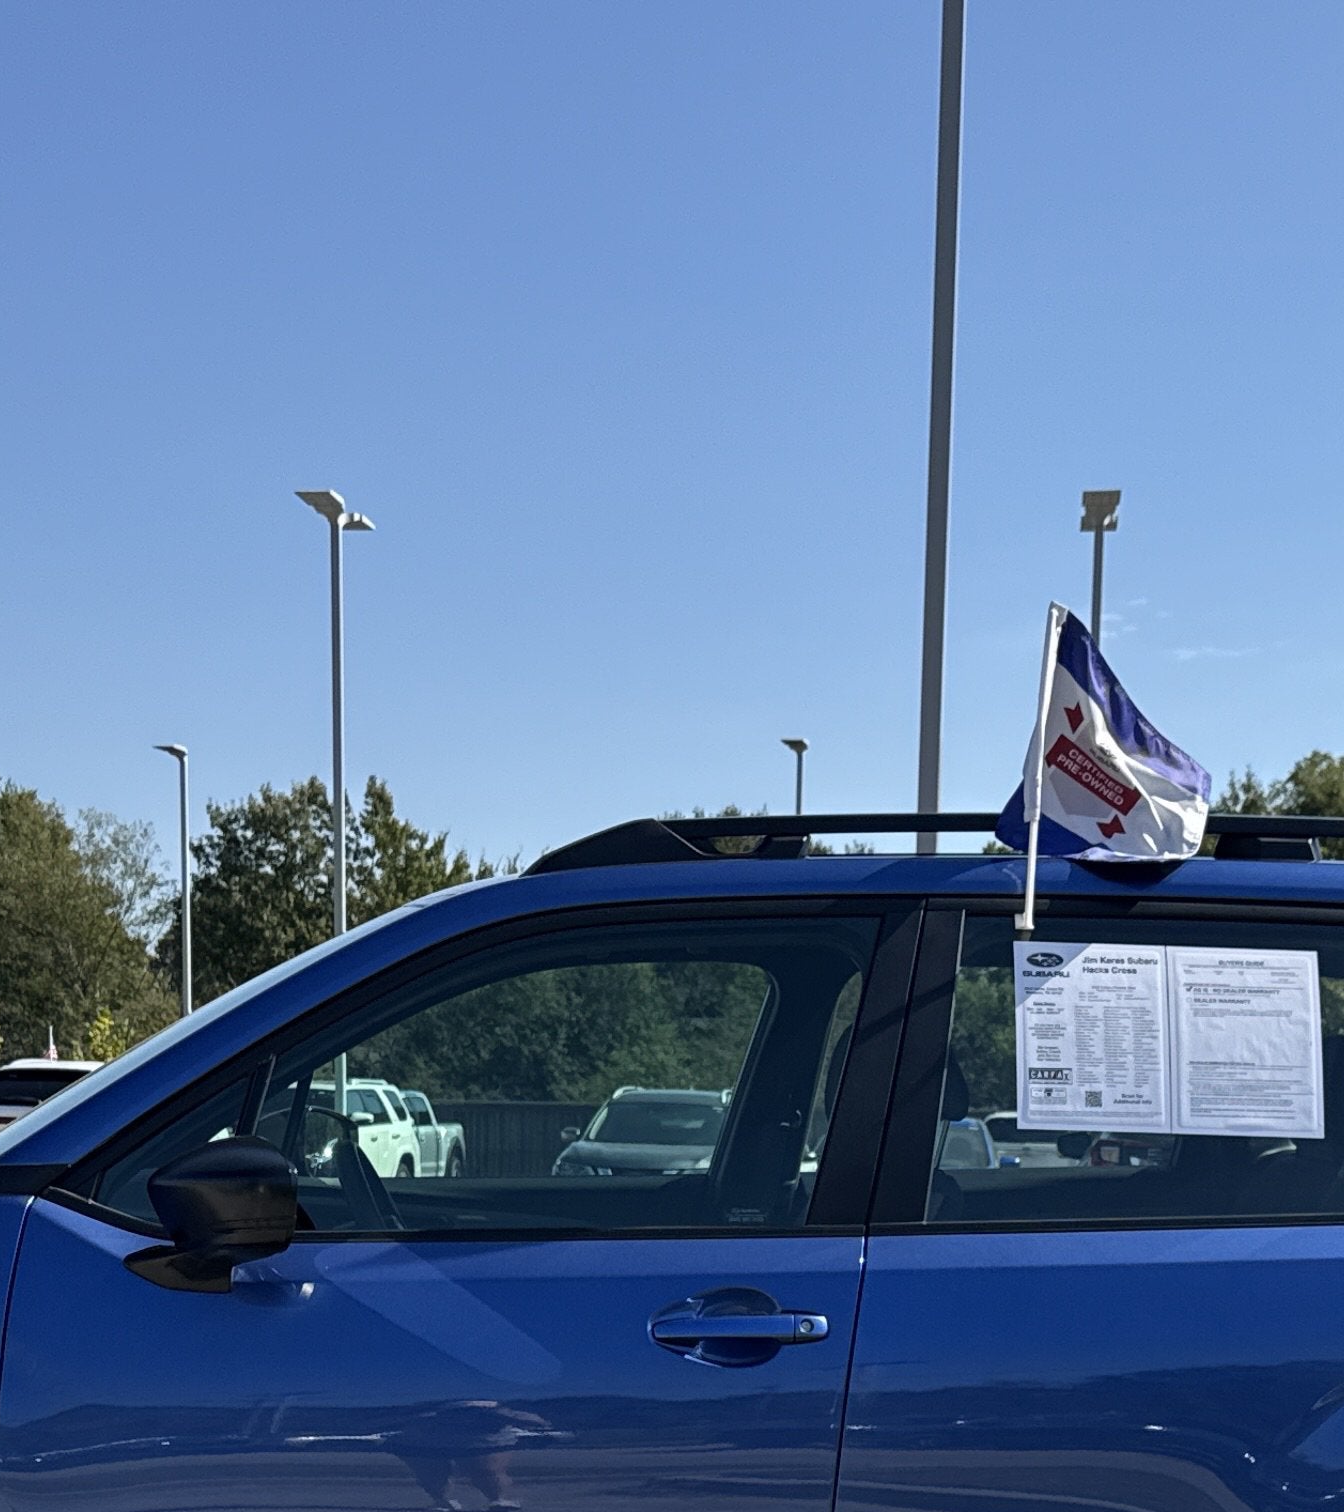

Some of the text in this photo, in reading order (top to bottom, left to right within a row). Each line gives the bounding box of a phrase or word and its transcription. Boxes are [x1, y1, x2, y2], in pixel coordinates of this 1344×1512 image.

[1068, 748, 1124, 794] CERTIFIED
[1056, 753, 1125, 807] PRE-OWNED
[1081, 956, 1098, 965] Jim
[1127, 957, 1159, 965] Subaru
[1022, 970, 1071, 978] SUBARU
[1030, 1069, 1071, 1081] CARFAX
